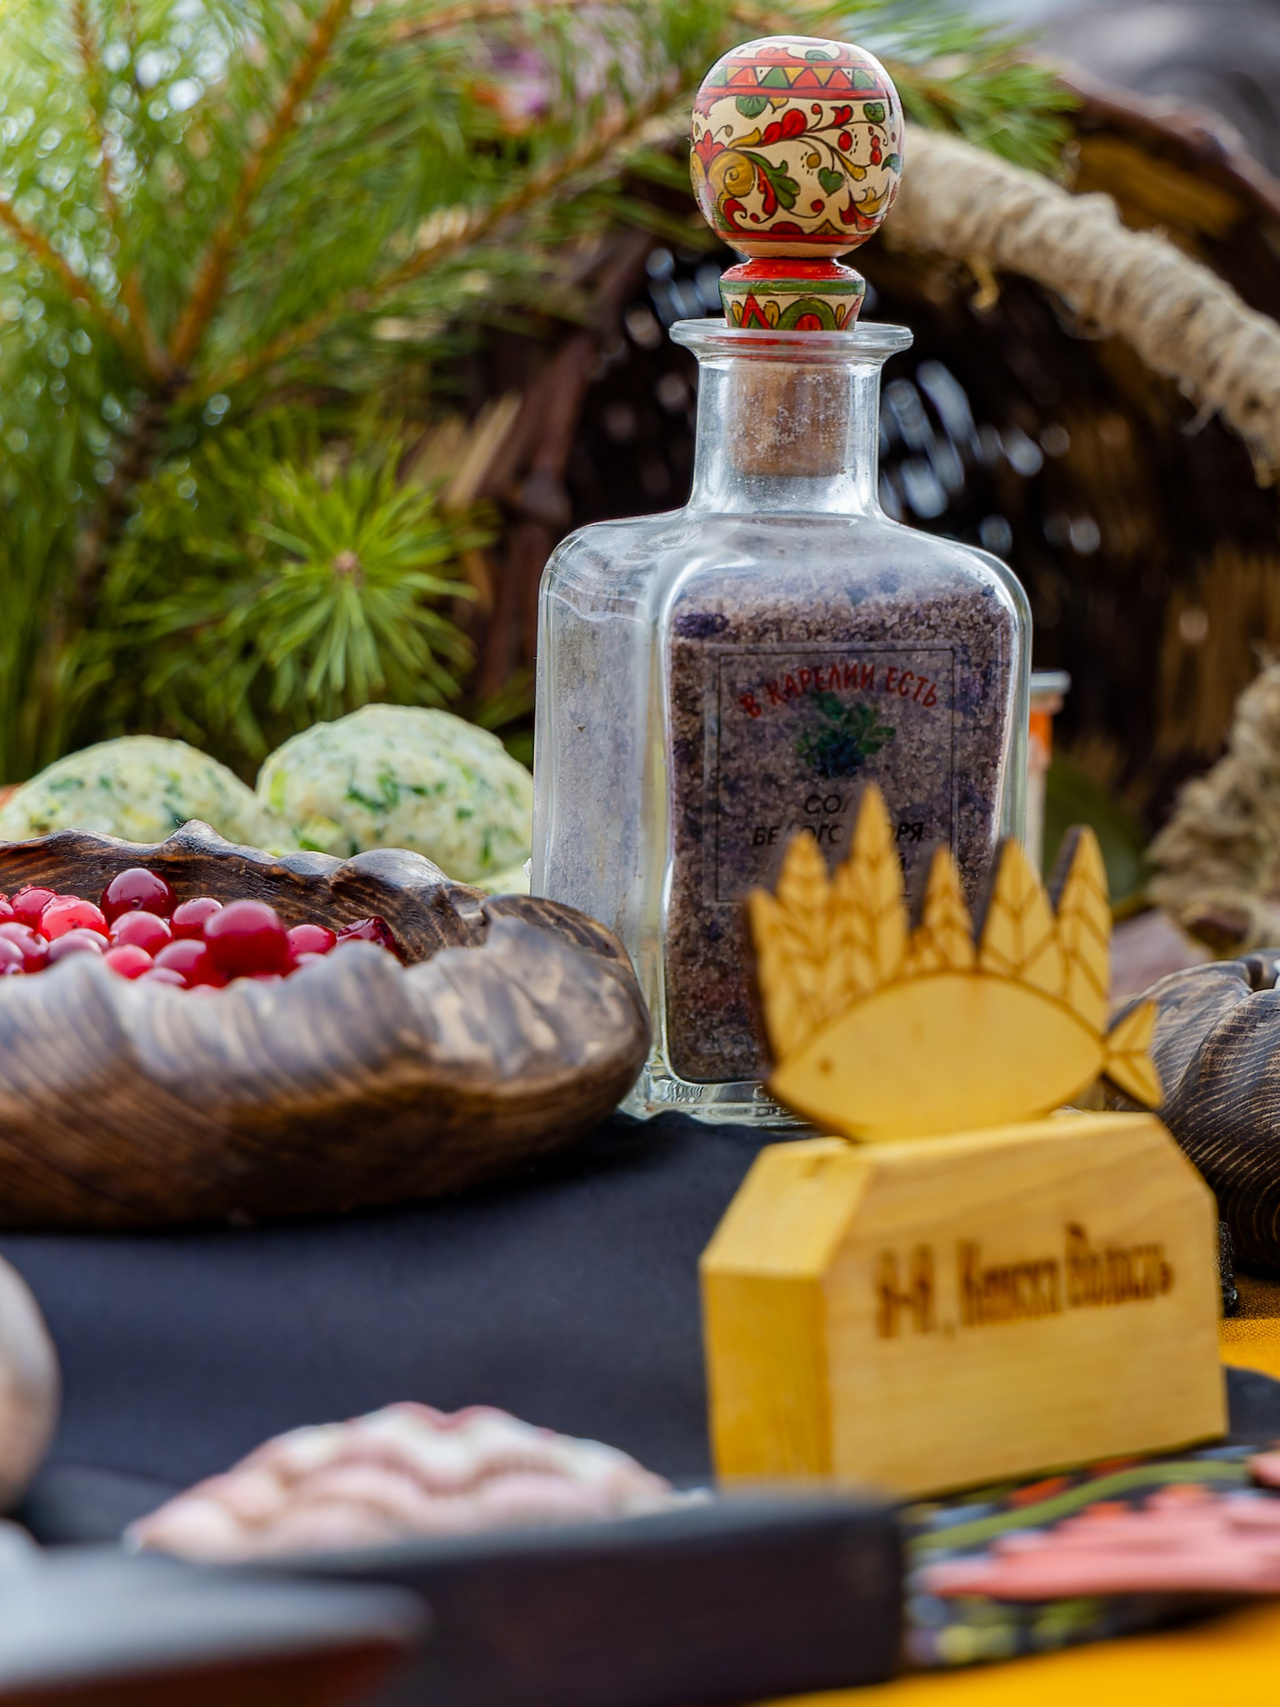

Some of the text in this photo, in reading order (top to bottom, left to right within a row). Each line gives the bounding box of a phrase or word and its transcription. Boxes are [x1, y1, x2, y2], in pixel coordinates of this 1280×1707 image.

[740, 662, 938, 718] В КАРЕЛИИ ЕСТЬ
